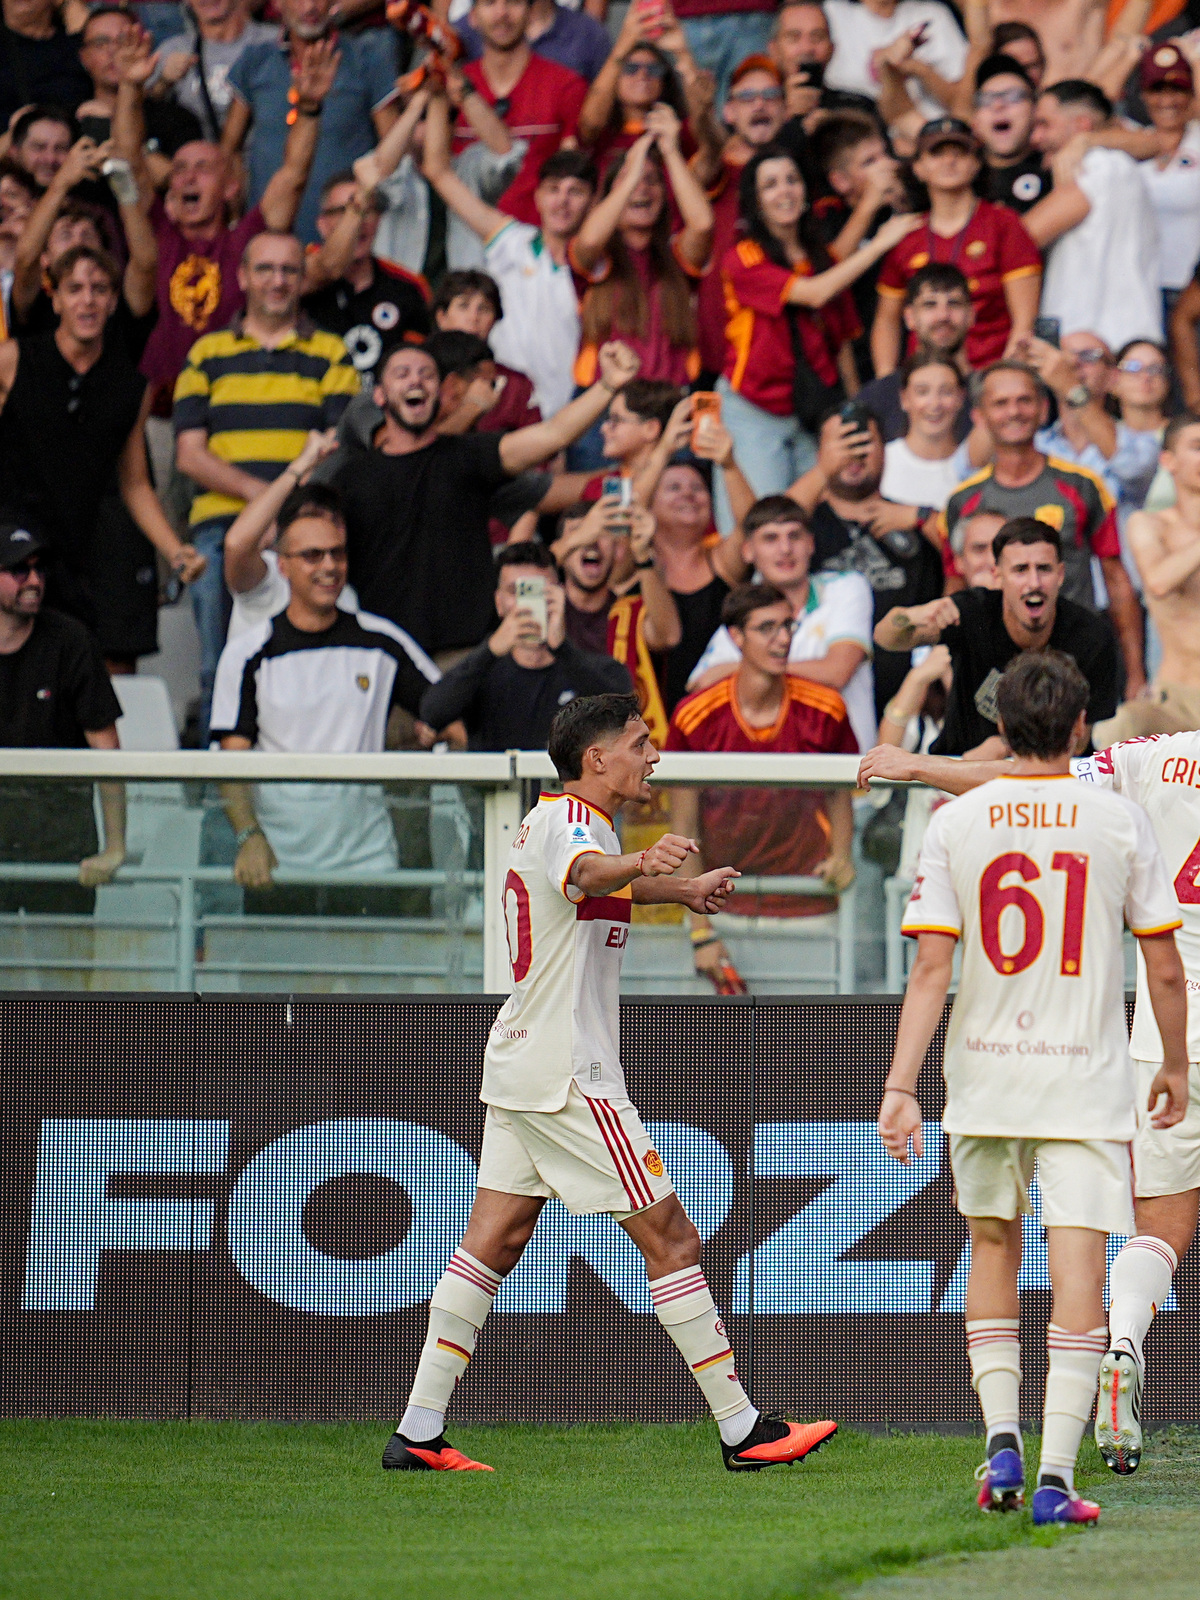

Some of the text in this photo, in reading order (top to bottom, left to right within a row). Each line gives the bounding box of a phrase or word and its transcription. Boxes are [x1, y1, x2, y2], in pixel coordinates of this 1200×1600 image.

[990, 802, 1078, 829] PISILLI
[980, 851, 1089, 976] 61
[1016, 1039, 1089, 1056] Collection
